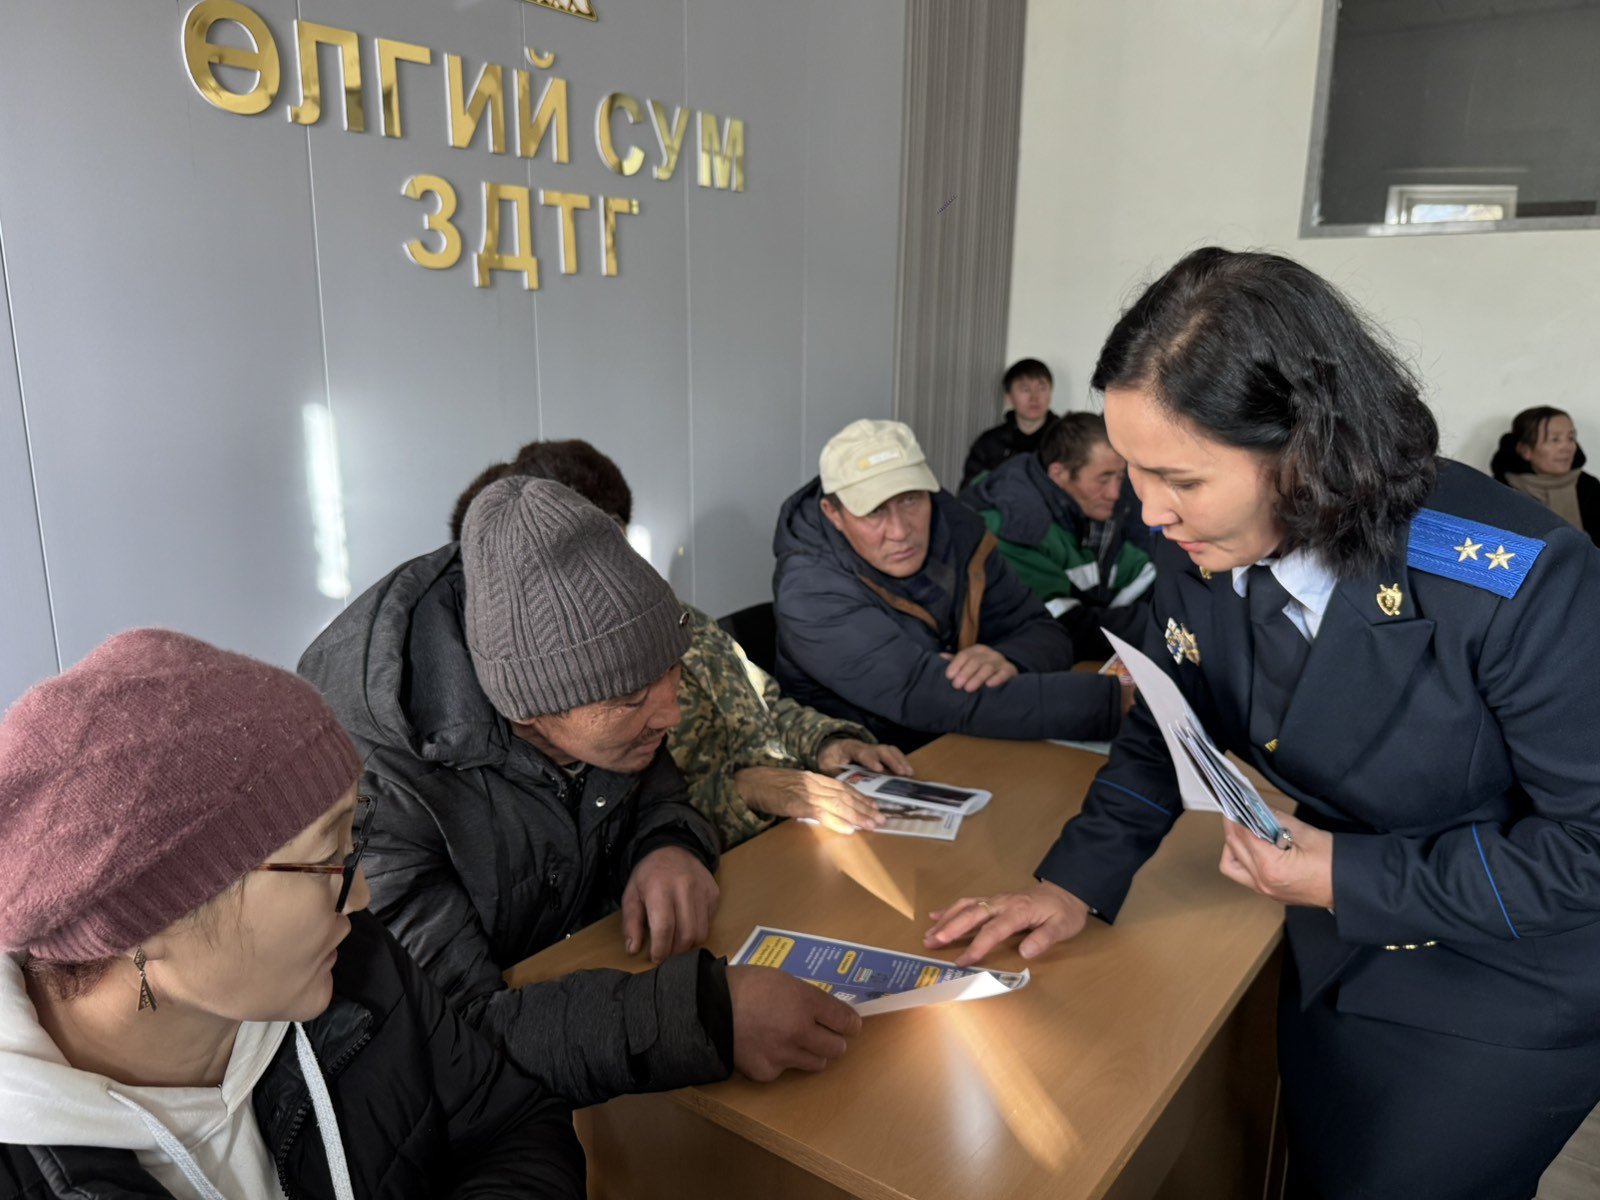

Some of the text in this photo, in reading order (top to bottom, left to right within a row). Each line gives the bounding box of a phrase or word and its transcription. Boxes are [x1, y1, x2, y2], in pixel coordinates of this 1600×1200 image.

[181, 0, 745, 192] ӨЛГИЙ СУМ
[400, 174, 640, 290] ЗДТГ
